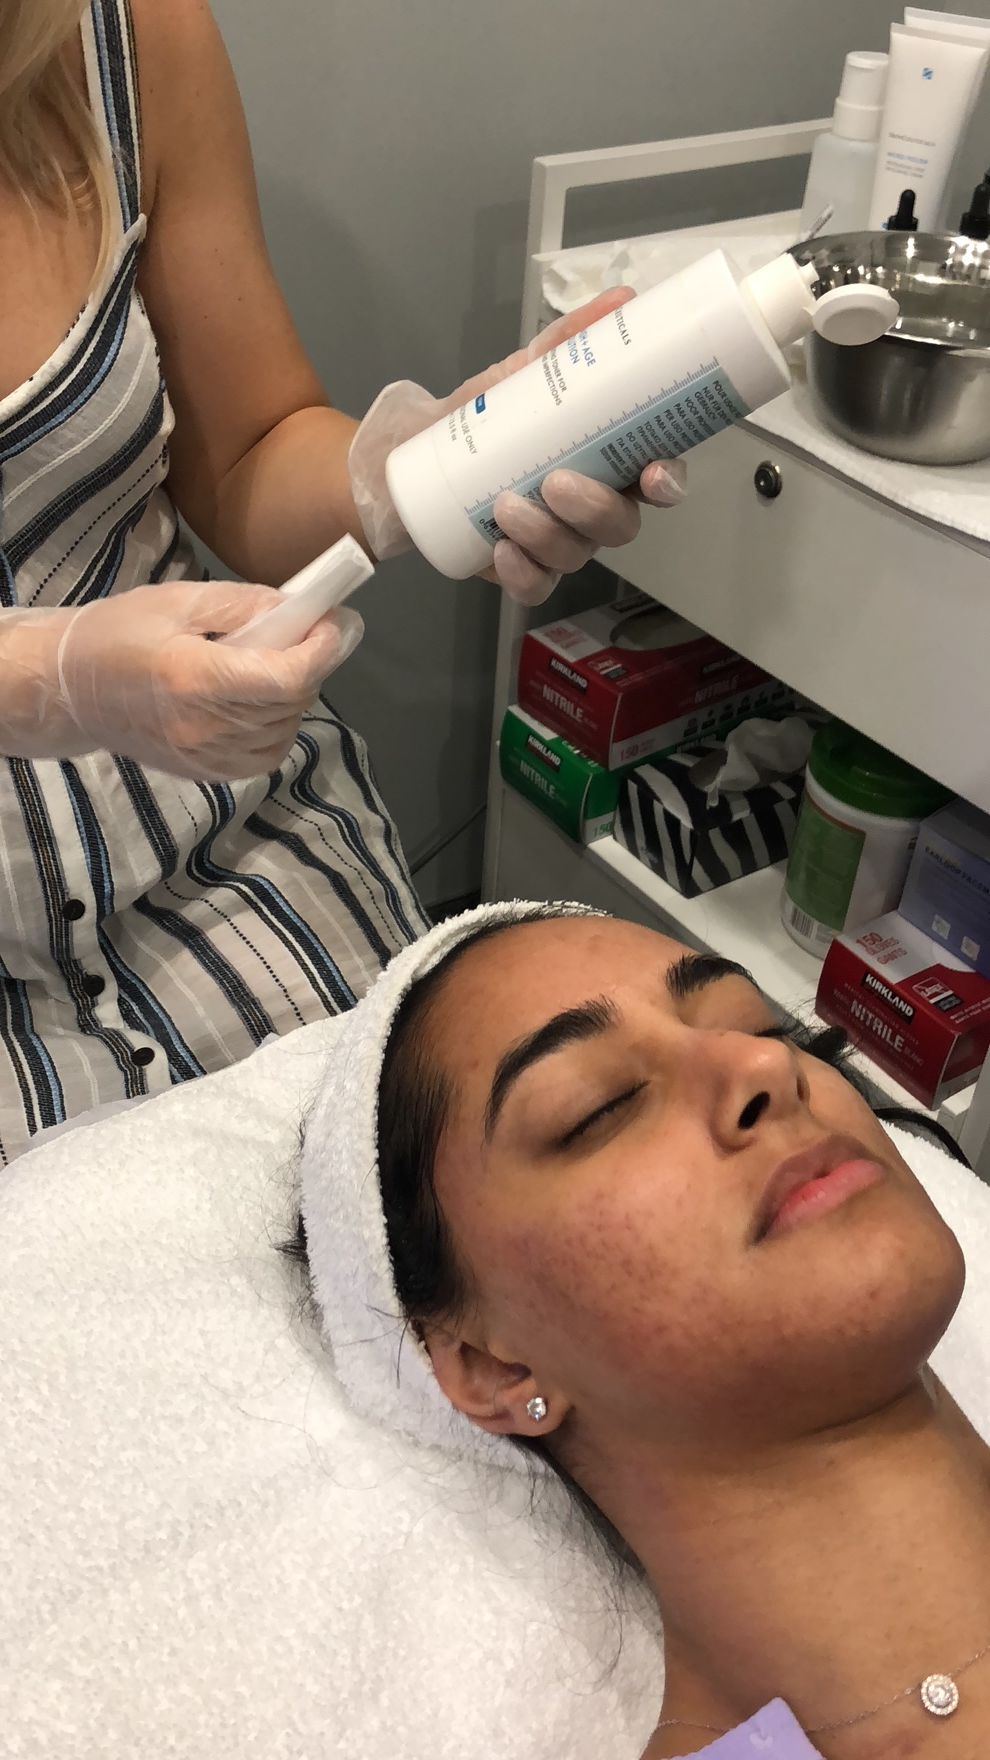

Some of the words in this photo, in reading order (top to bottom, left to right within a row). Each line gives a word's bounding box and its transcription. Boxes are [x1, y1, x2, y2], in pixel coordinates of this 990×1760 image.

[583, 346, 596, 368] AGE
[542, 363, 562, 406] IMPERFECTIONS
[558, 379, 567, 393] FOR
[654, 416, 667, 430] PARA
[664, 410, 674, 421] PER
[674, 404, 686, 419] PARA
[466, 435, 478, 454] ONLY
[550, 657, 588, 689] KIRKLAND
[542, 684, 585, 724] NITRILE
[528, 734, 561, 766] KIRKLAND
[520, 760, 557, 800] NITRILE
[856, 931, 882, 948] 150
[864, 973, 914, 1018] KIRKLAND
[850, 1000, 906, 1052] NITRILE
